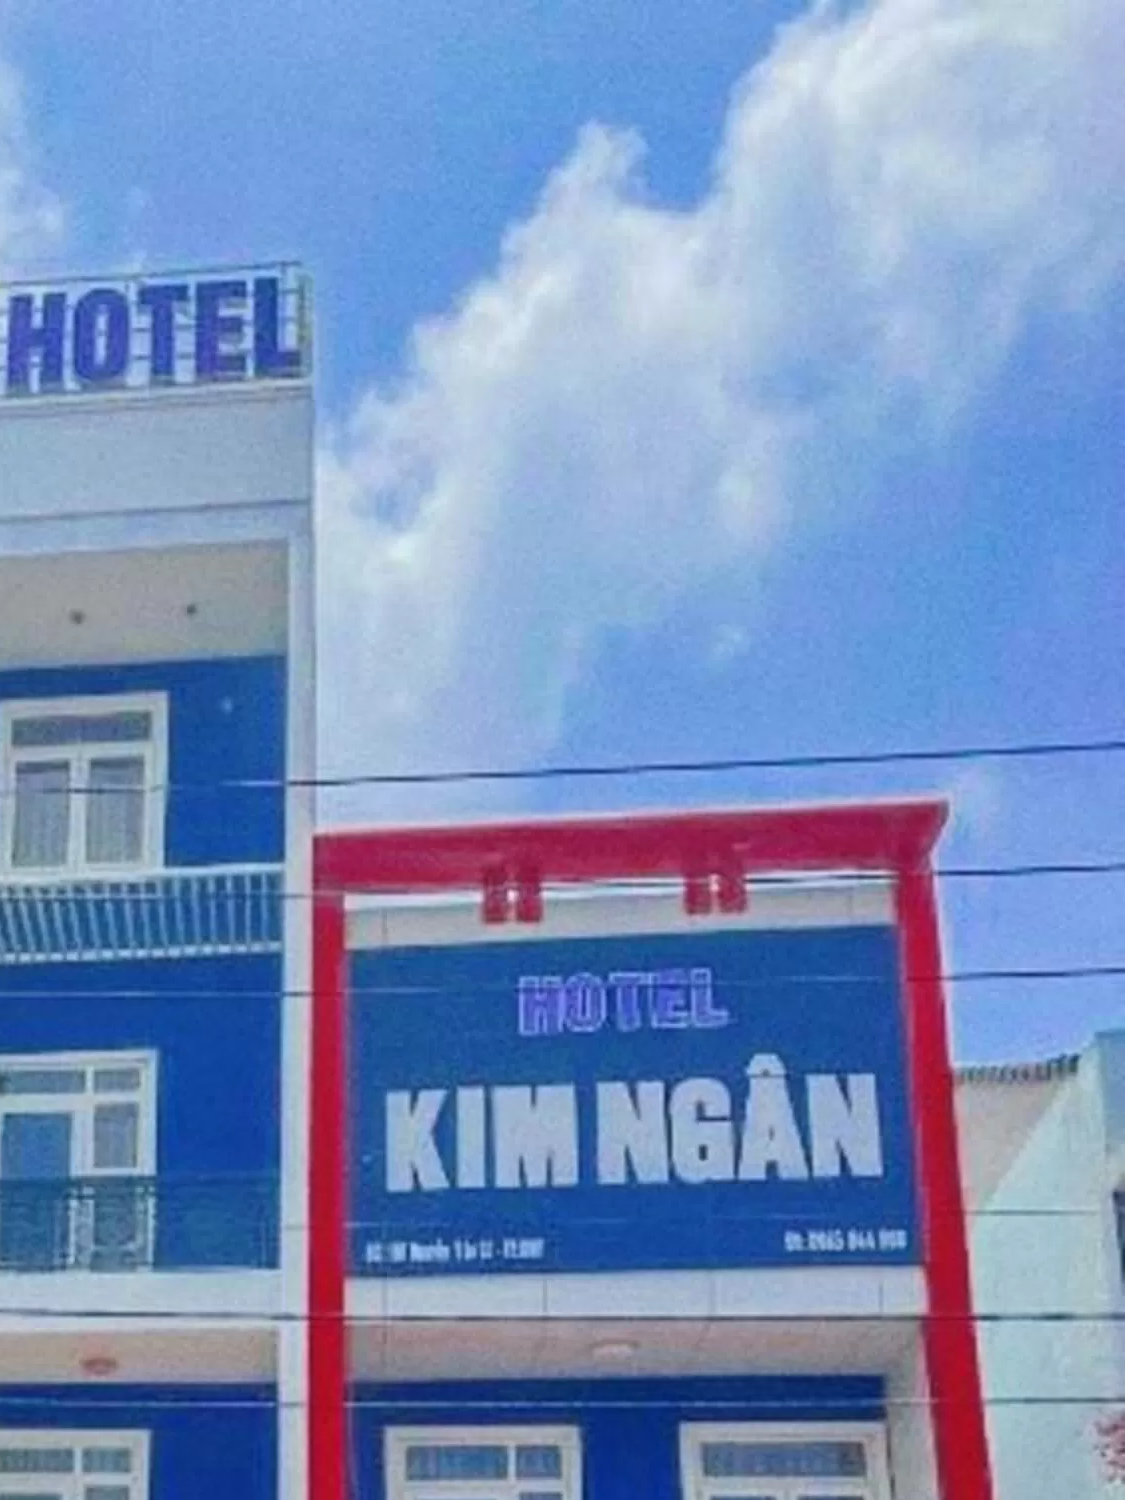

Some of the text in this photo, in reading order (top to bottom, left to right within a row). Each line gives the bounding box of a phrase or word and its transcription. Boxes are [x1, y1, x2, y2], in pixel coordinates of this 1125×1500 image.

[7, 277, 300, 386] HOTEL
[518, 967, 729, 1036] HOTEL
[385, 1052, 884, 1193] KIM NGÂN
